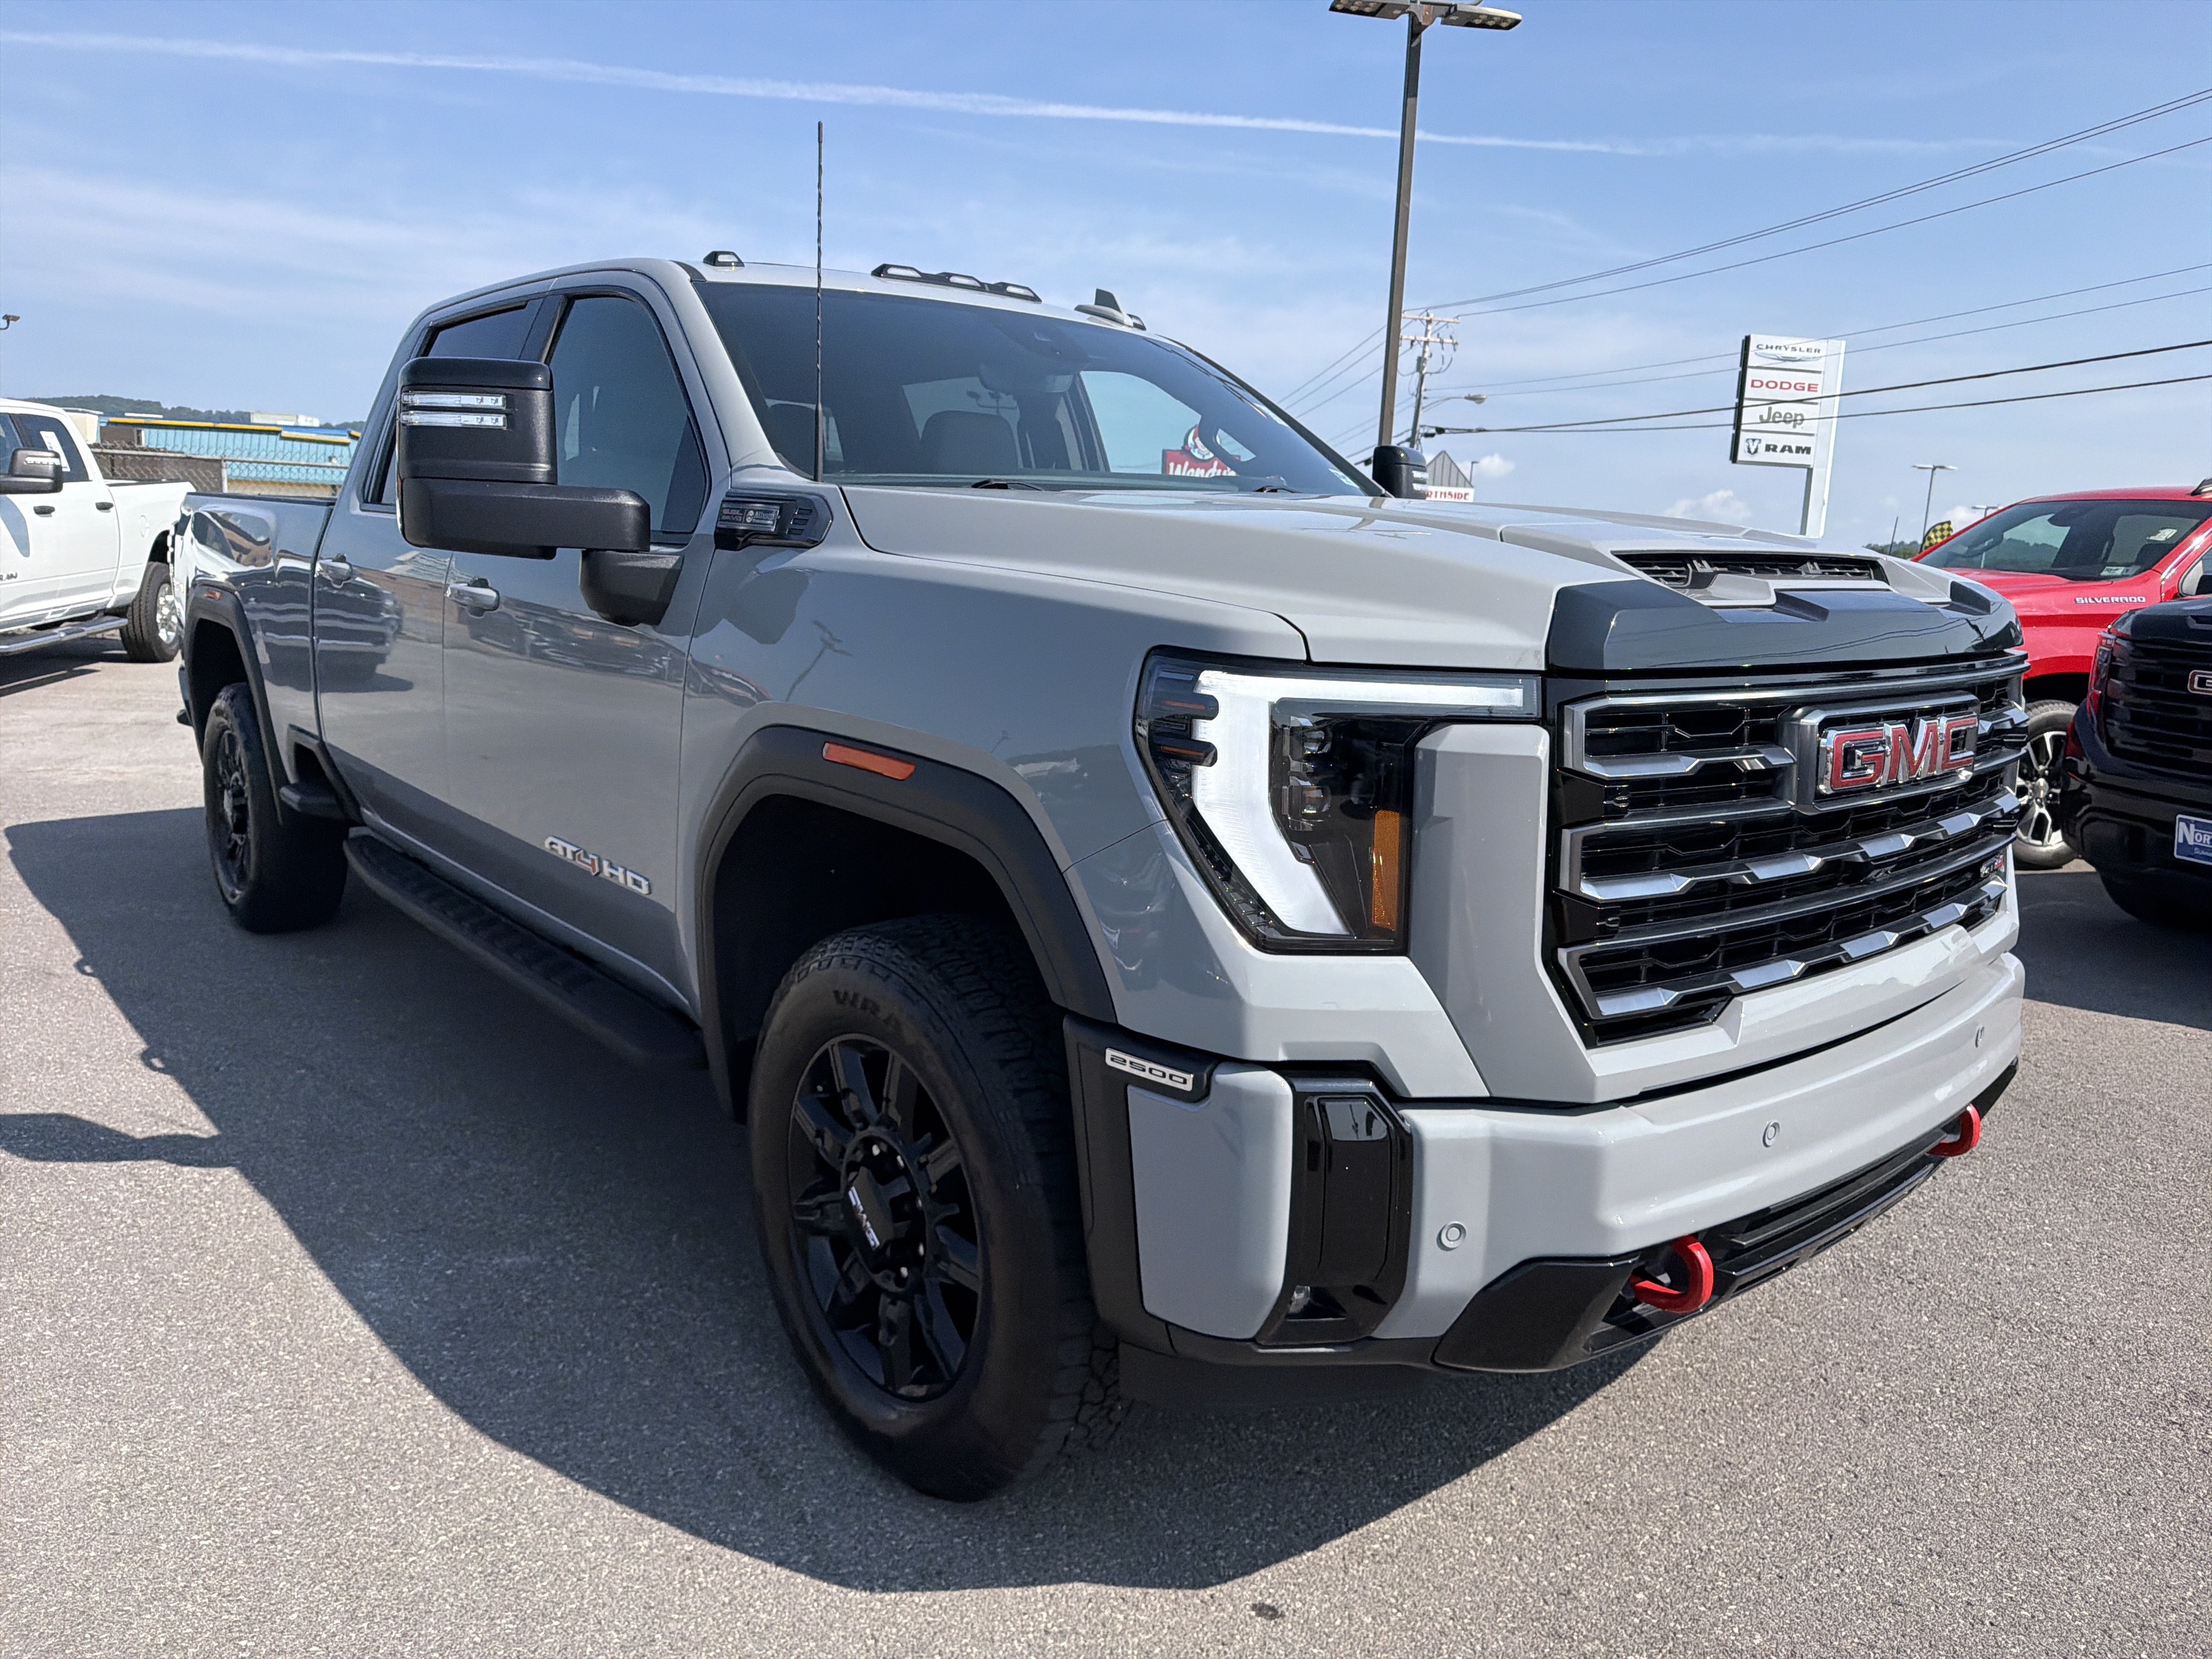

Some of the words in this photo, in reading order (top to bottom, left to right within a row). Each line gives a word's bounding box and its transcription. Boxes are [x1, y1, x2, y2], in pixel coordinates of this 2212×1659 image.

[1756, 343, 1821, 354] CHRYSLER
[1750, 379, 1819, 392] DODGE
[1759, 406, 1805, 428] Jeep
[1764, 443, 1812, 455] RAM
[1426, 490, 1470, 501] RTHSIDE
[2075, 596, 2146, 604] SILVERADO
[1816, 714, 1979, 794] GMC
[545, 835, 601, 876] AT4
[602, 859, 652, 895] HD
[1110, 1053, 1188, 1085] 2500
